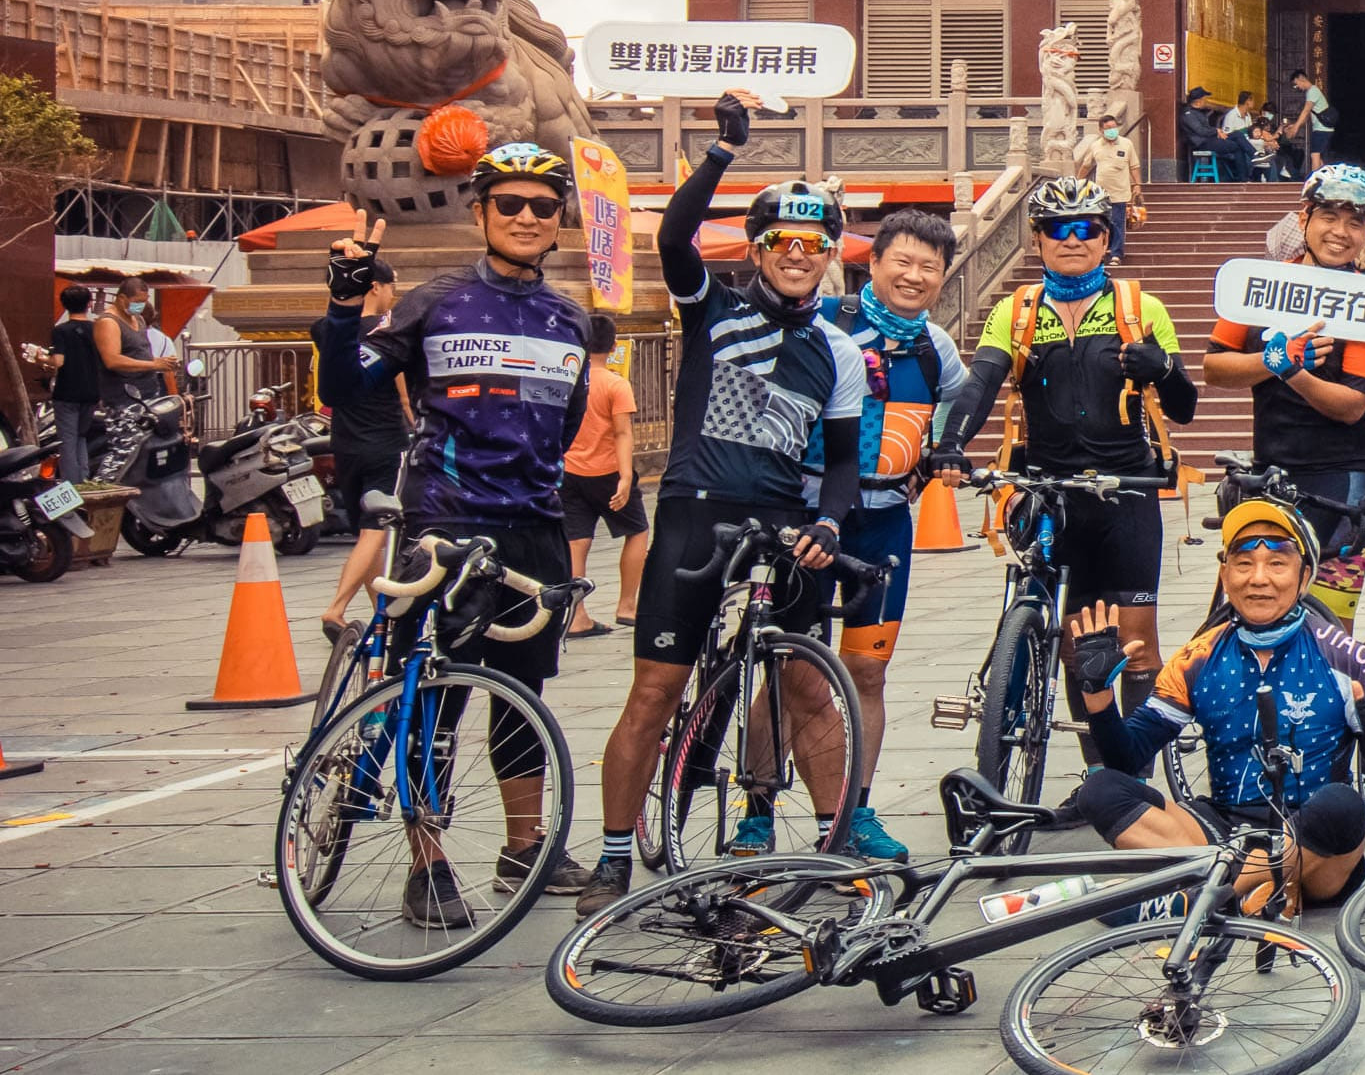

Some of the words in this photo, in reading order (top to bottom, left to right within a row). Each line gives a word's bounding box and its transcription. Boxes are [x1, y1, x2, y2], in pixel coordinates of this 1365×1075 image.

[608, 41, 818, 74] 雙鐵漫遊屏東
[785, 200, 822, 217] 102
[441, 338, 512, 353] CHINESE
[445, 355, 494, 369] TAIPEI
